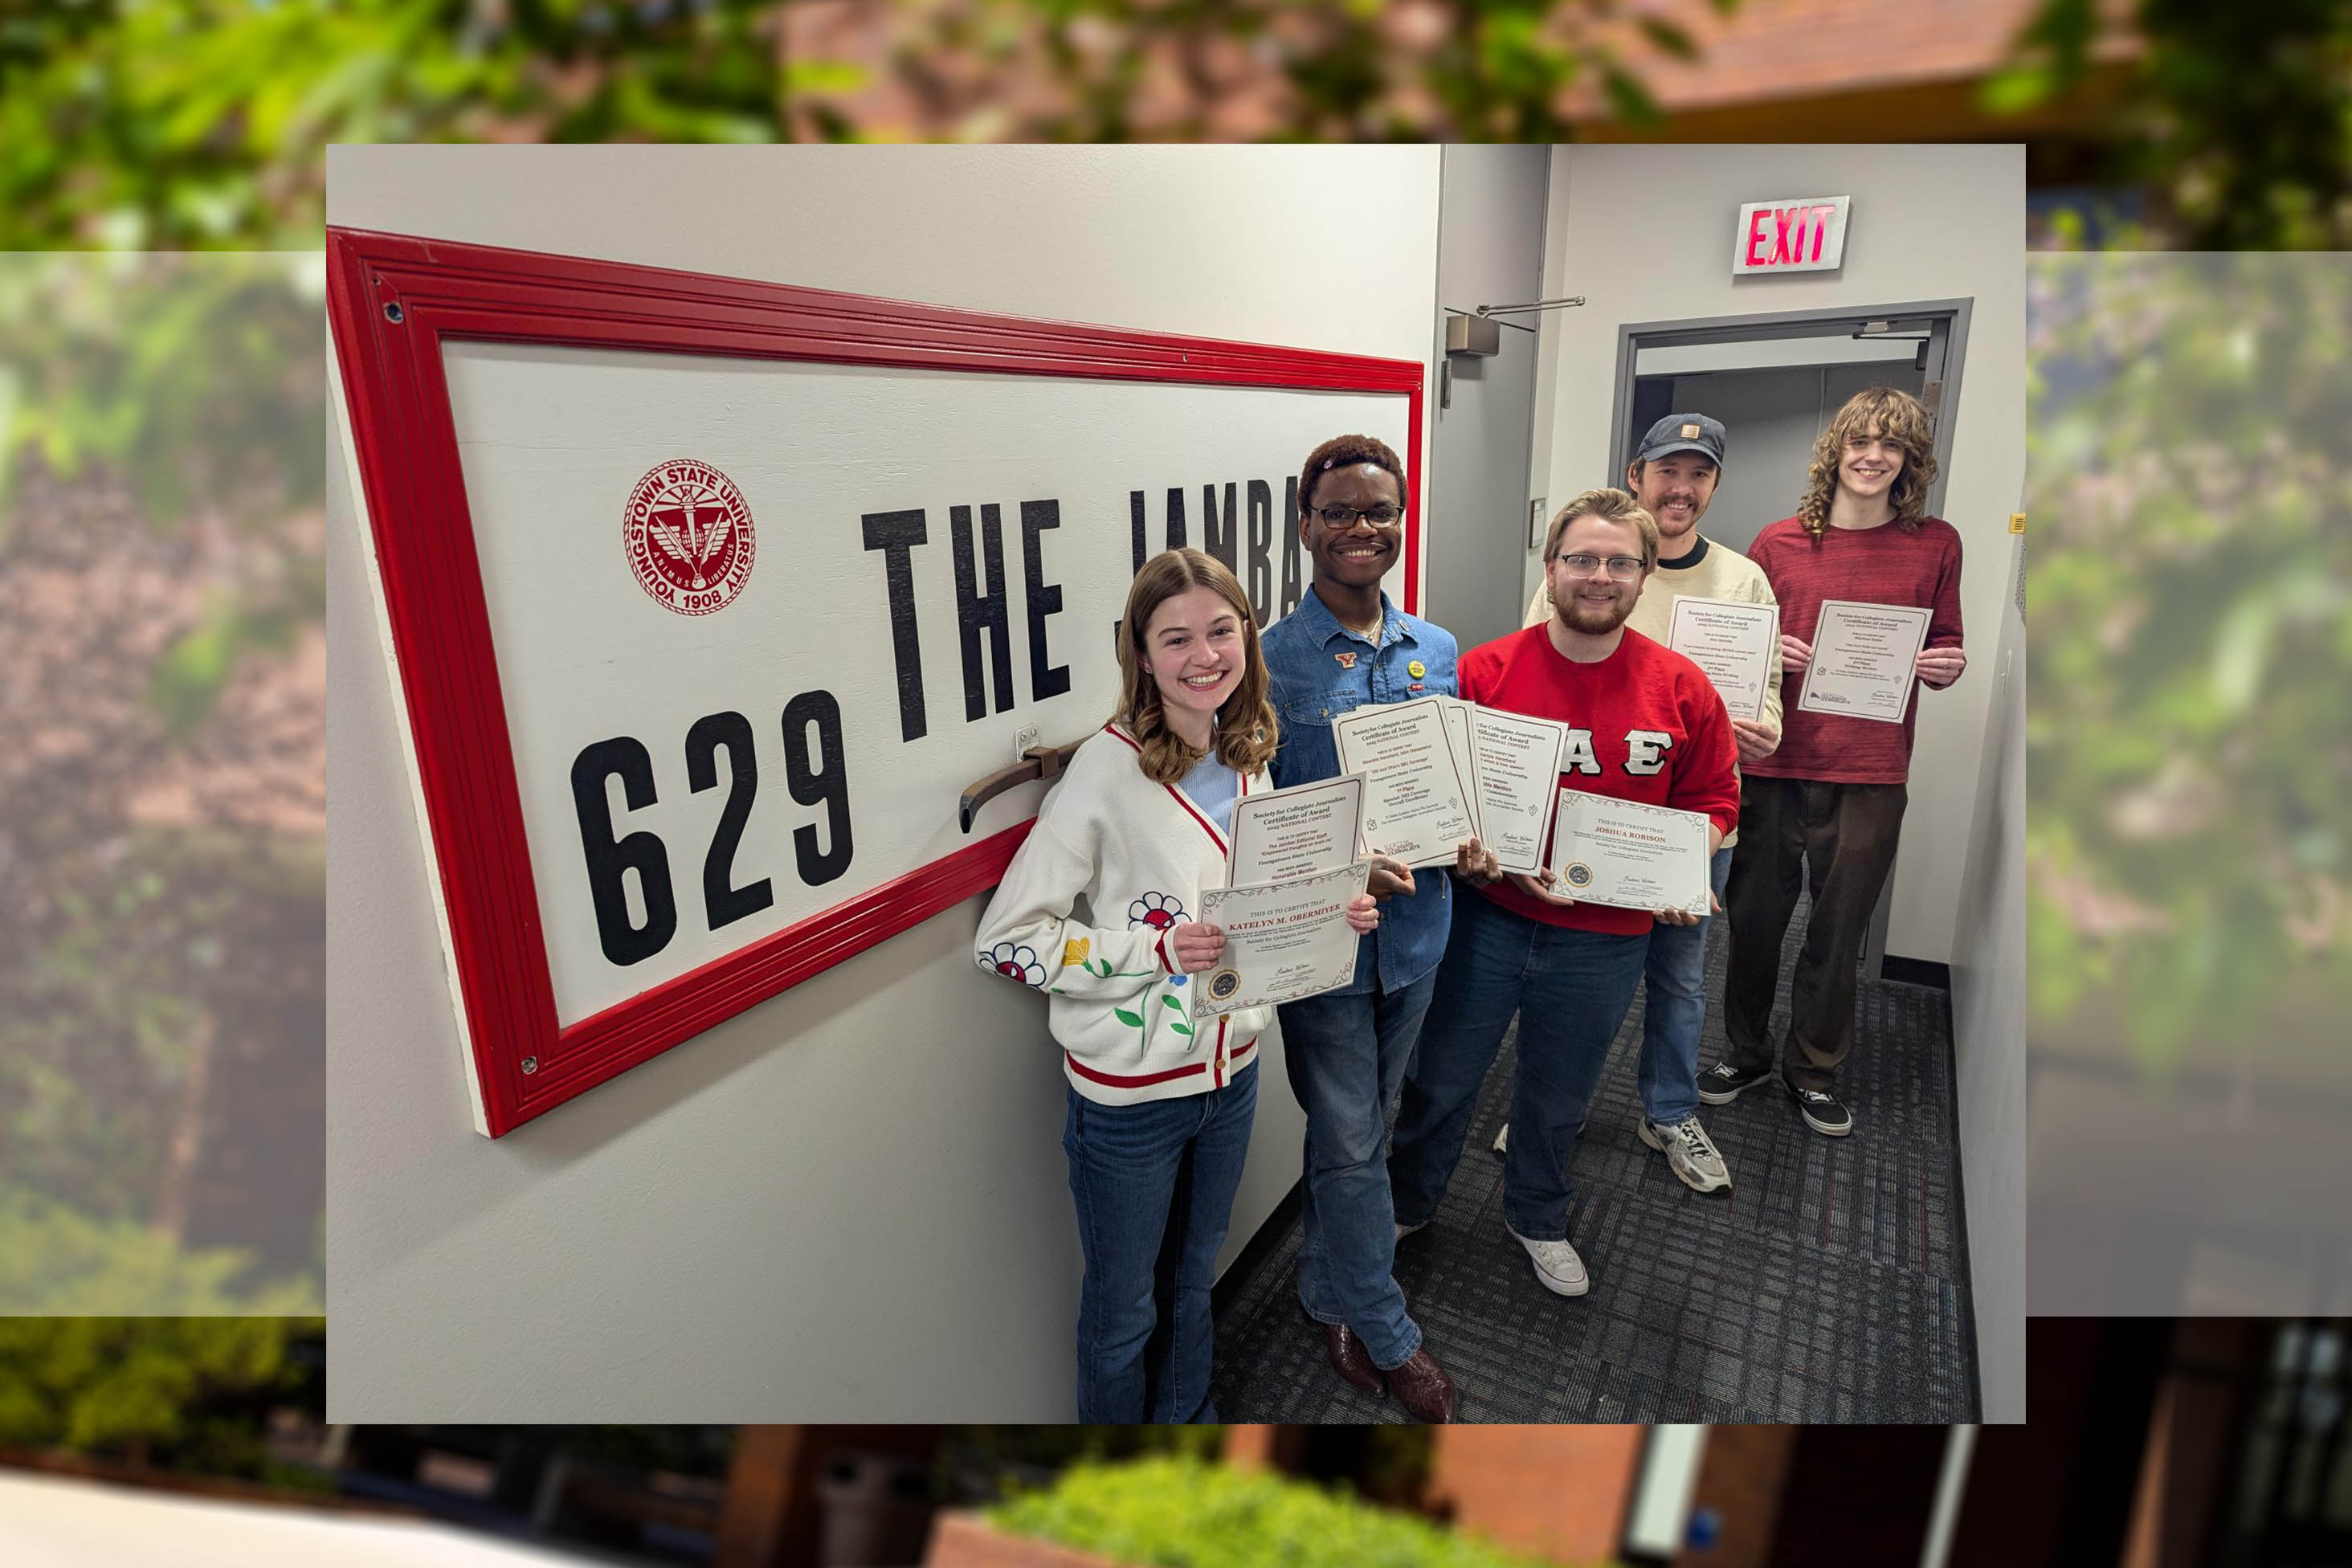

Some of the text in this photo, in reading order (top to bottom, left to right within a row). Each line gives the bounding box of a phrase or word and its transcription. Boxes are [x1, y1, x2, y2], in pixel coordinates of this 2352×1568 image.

[1746, 205, 1835, 266] EXIT
[631, 468, 750, 604] YOUNGSTOWN STATE UNIVERSITY
[652, 543, 734, 588] ANIMUS LIBERATUS
[683, 590, 721, 609] 1908
[862, 499, 1071, 743] THE
[1402, 715, 1428, 725] Journalists
[1488, 725, 1514, 734] Collegiate
[1362, 731, 1390, 741] Certificate
[1398, 723, 1416, 732] Award
[1561, 729, 1673, 776] A E
[1253, 811, 1276, 819] Society
[1286, 803, 1314, 813] Collegiate
[1315, 796, 1346, 807] Journalists
[1264, 814, 1299, 826] Certificate
[1309, 806, 1329, 816] Award
[570, 688, 855, 966] 629
[1280, 819, 1308, 828] NATIONAL
[1309, 813, 1332, 822] CONTEST
[1594, 826, 1627, 837] JOSHUA
[1629, 832, 1665, 843] ROBISON
[1272, 871, 1296, 880] Honorable
[1284, 902, 1309, 913] CERTIFY
[1310, 898, 1326, 907] THAT
[1229, 919, 1274, 931] KATELYN
[1289, 903, 1341, 922] OBERMIYER
